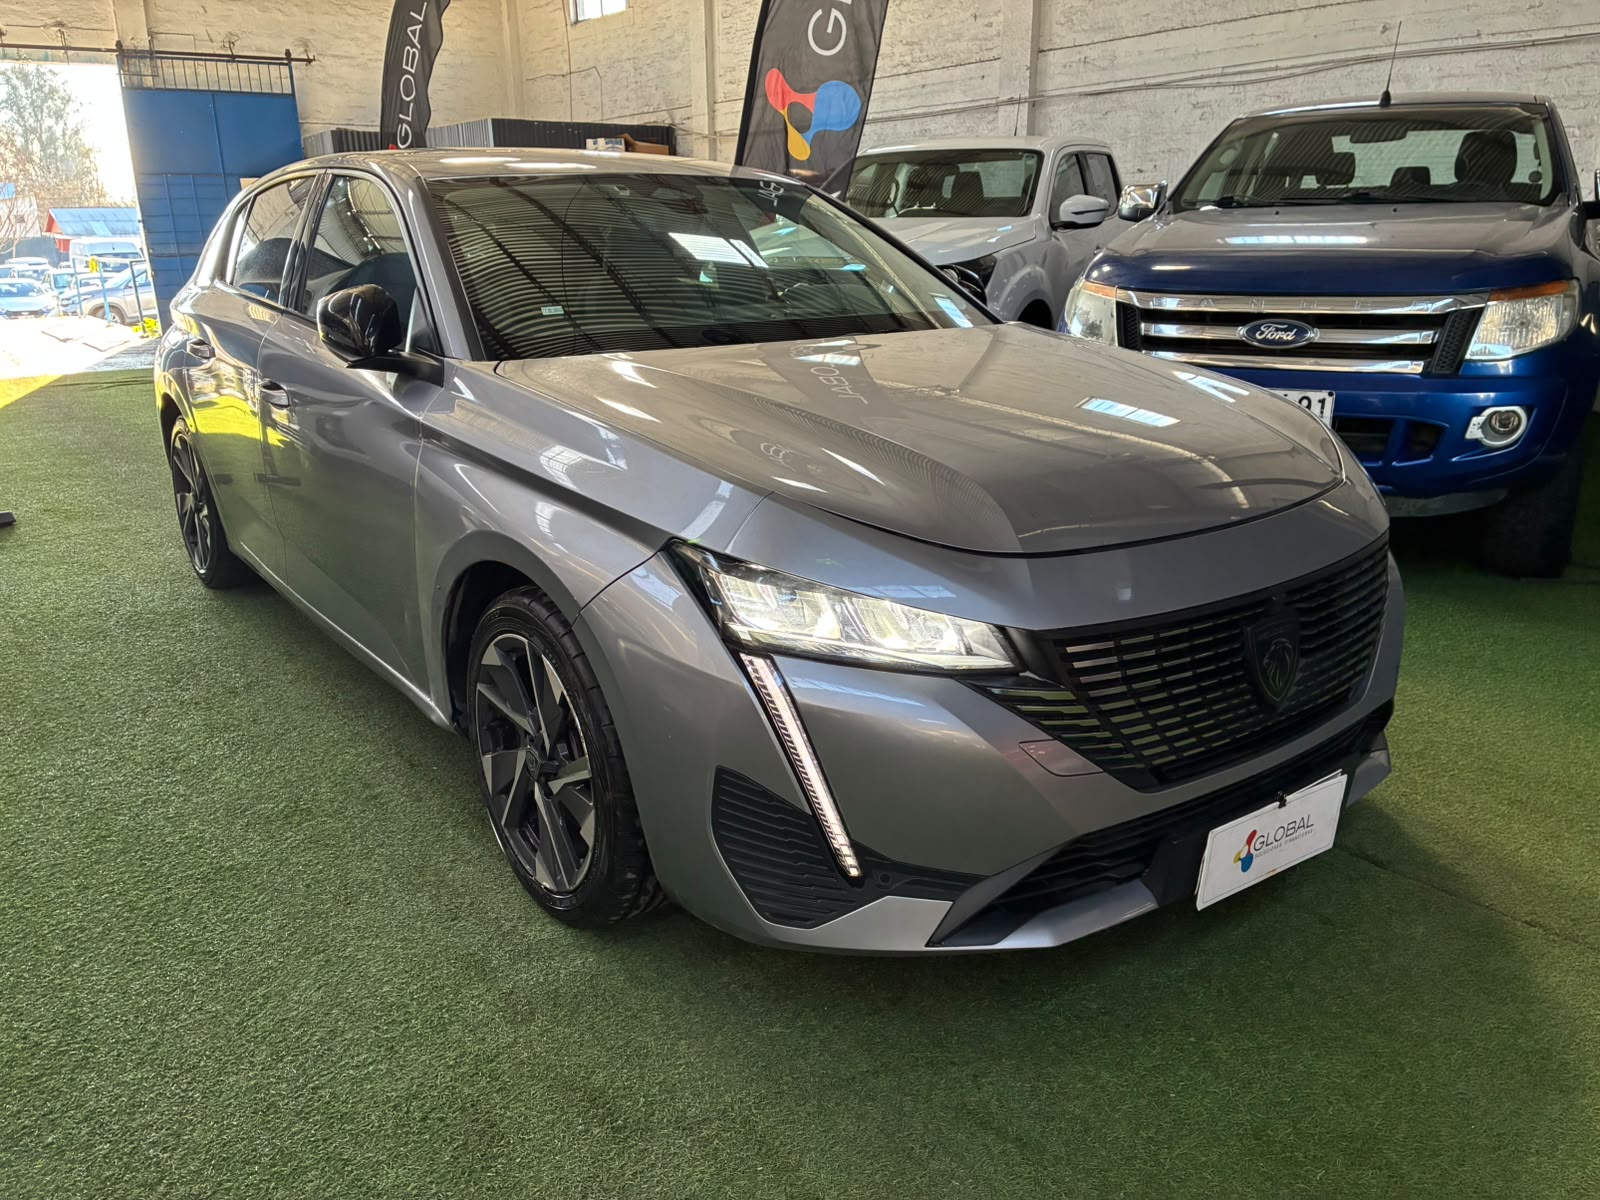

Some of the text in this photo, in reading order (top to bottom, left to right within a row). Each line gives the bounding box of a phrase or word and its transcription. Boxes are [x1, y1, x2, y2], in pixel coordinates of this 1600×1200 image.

[807, 0, 852, 56] G
[397, 2, 427, 149] GLOBAL
[1255, 323, 1298, 340] Ford
[1253, 814, 1314, 851] GLOBAL
